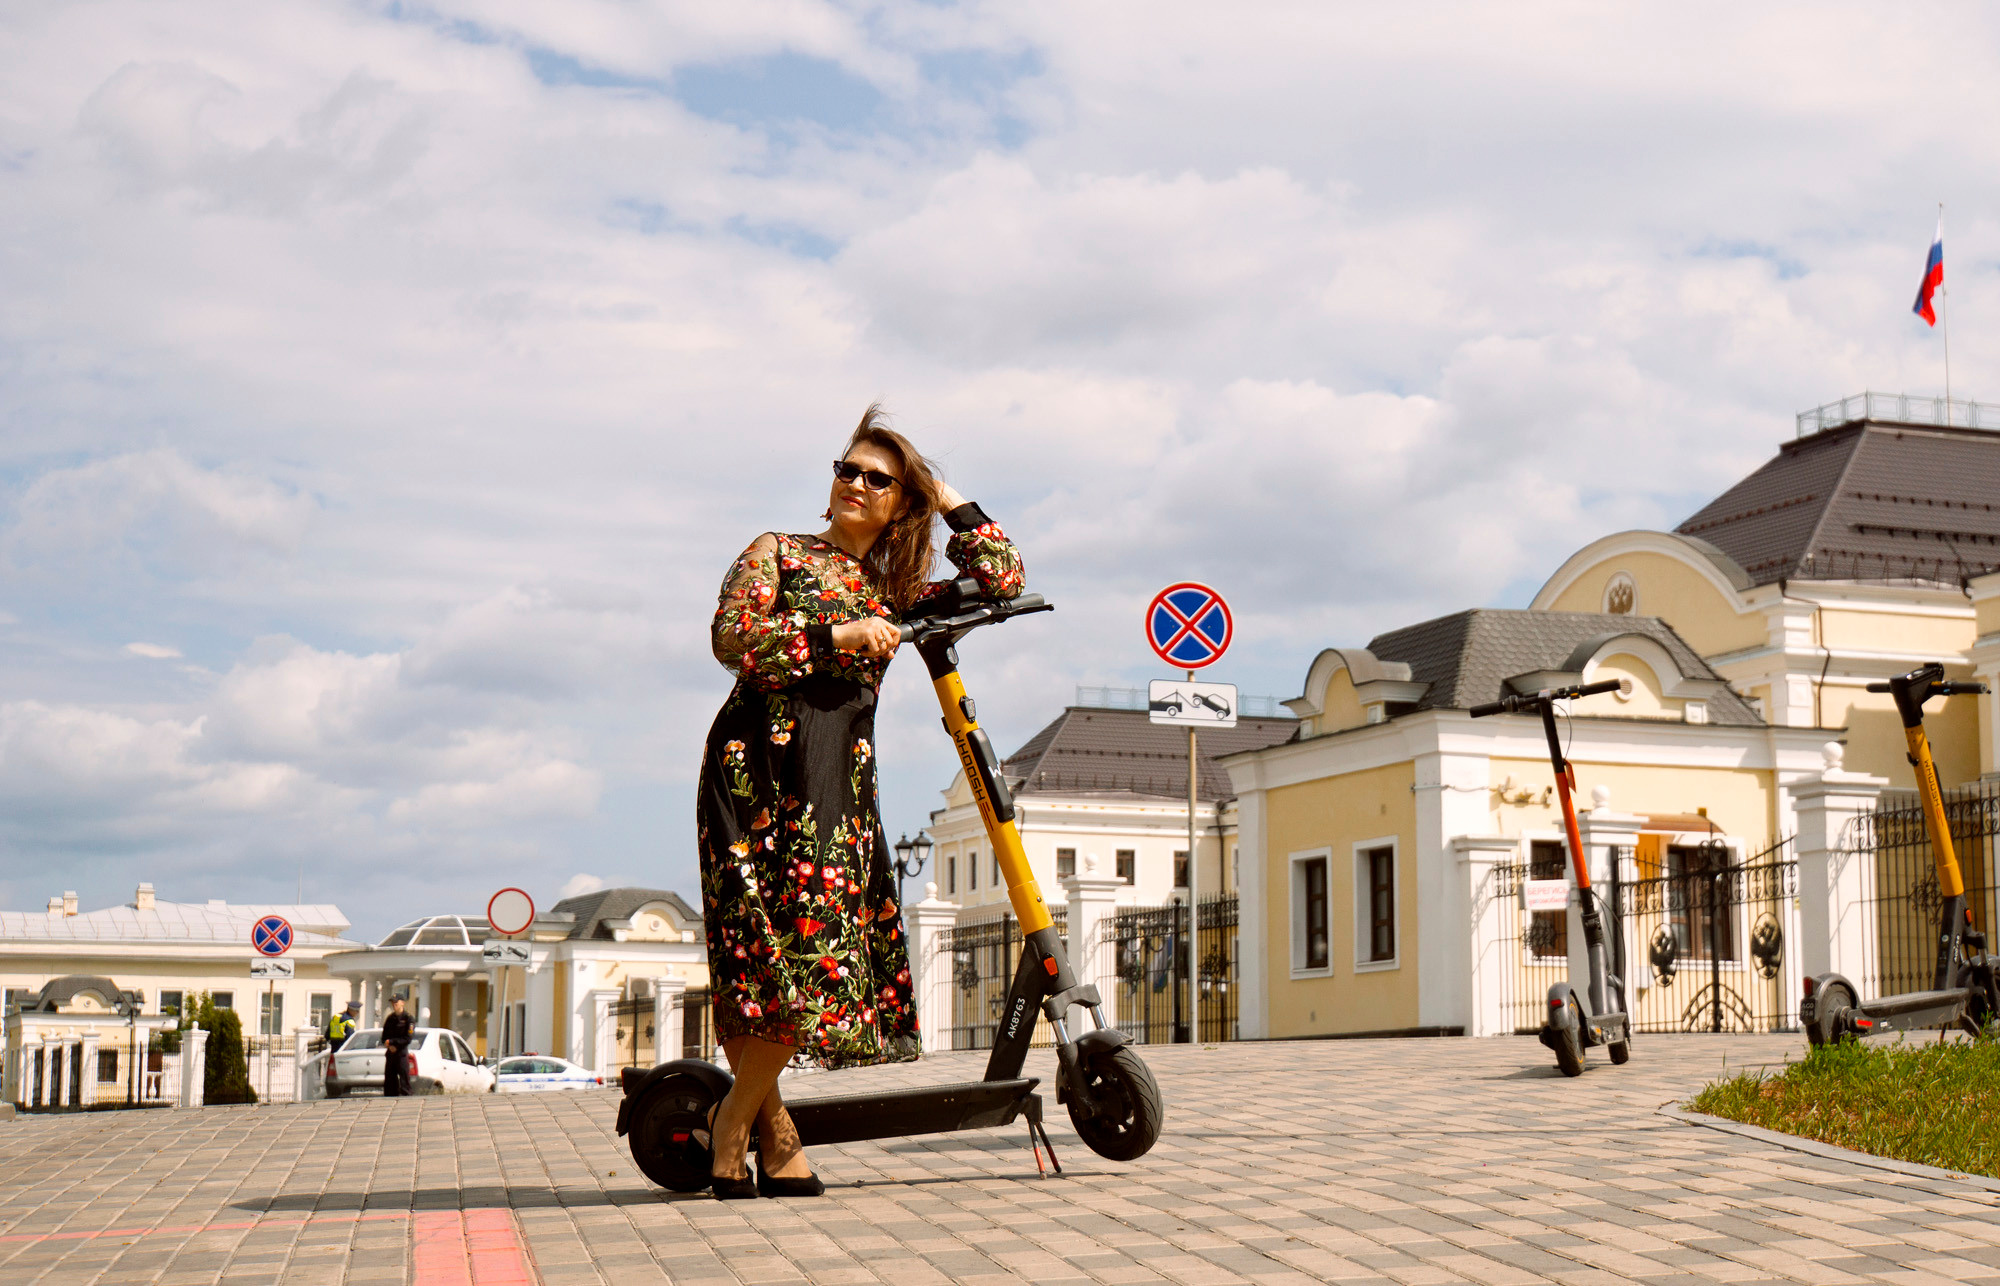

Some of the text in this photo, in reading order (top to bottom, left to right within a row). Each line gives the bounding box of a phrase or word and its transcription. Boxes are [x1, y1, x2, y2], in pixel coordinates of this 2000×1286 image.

[954, 730, 986, 801] WHOOSH
[1925, 759, 1940, 807] WHOOSH
[1007, 998, 1026, 1039] AK8763
